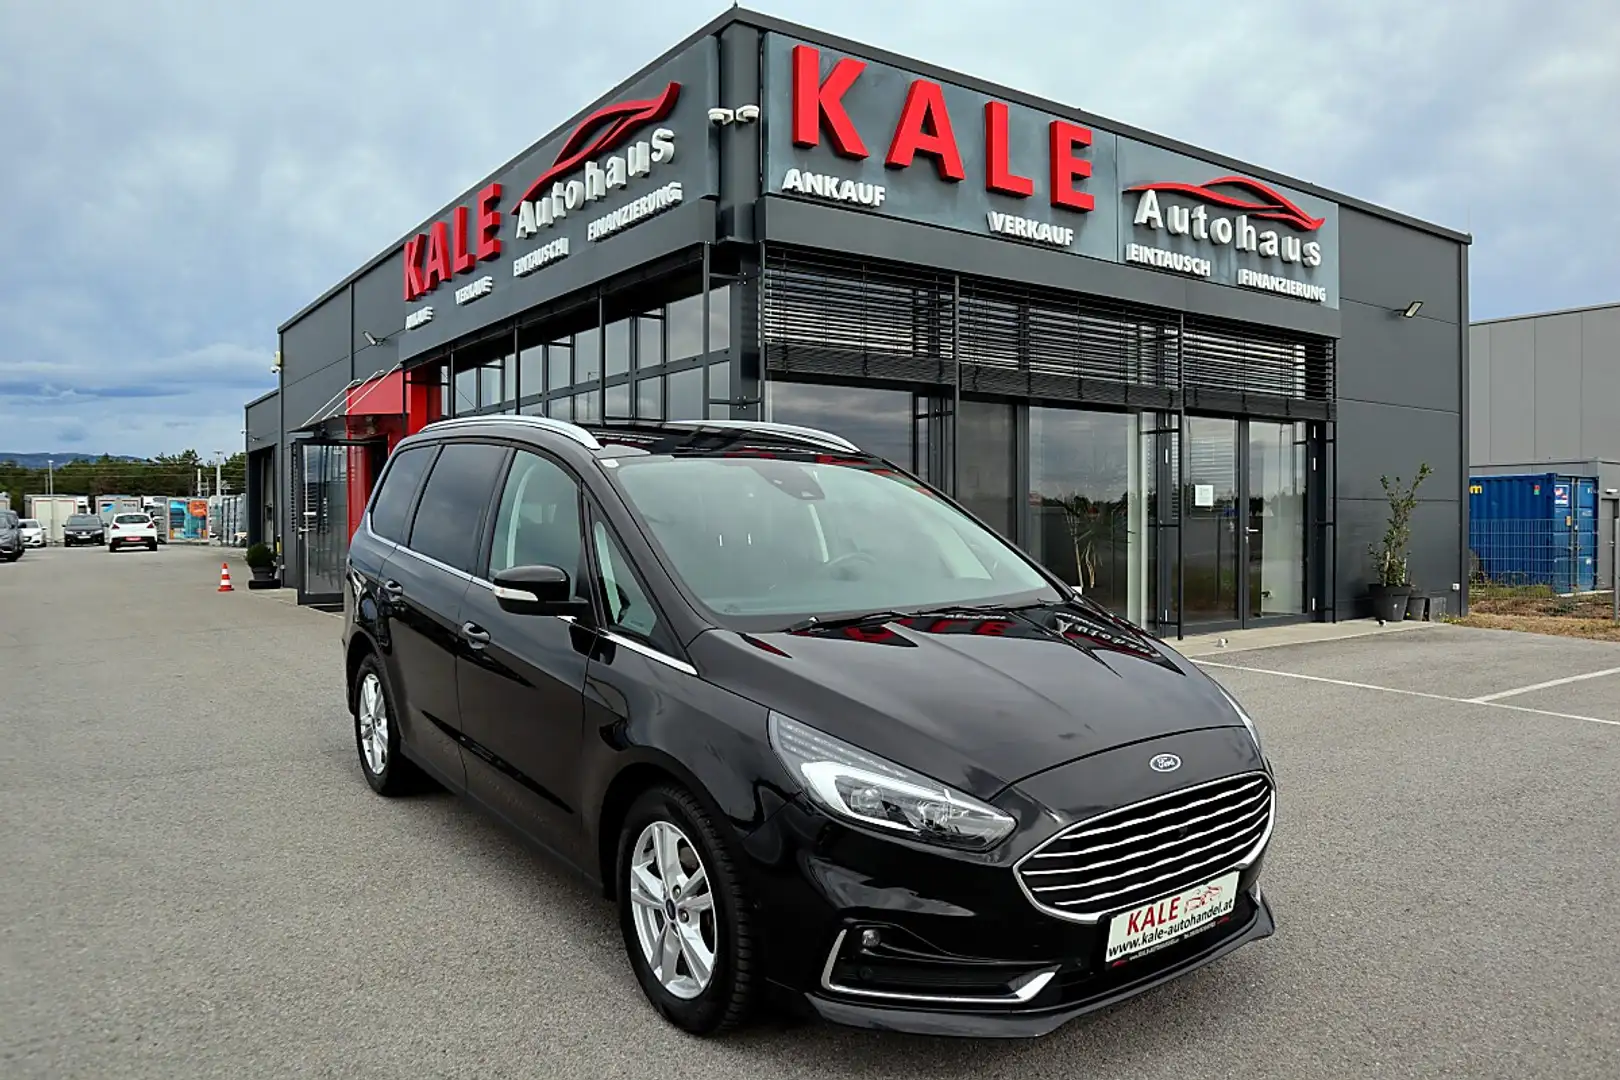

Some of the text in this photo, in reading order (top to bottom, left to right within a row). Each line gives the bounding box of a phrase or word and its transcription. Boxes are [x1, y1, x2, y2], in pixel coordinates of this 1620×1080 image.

[792, 44, 1095, 214] KALE
[516, 128, 676, 239] Autohaus
[587, 181, 683, 242] FINANZIERUNG
[1133, 189, 1322, 267] Autohaus
[403, 183, 502, 302] KALE
[782, 168, 1327, 302] ANKAUF VERKAUF EINTAUSCH FINANZIERUNG
[1108, 897, 1233, 957] www.kale-autohandel.at
[1127, 896, 1181, 937] KALE
